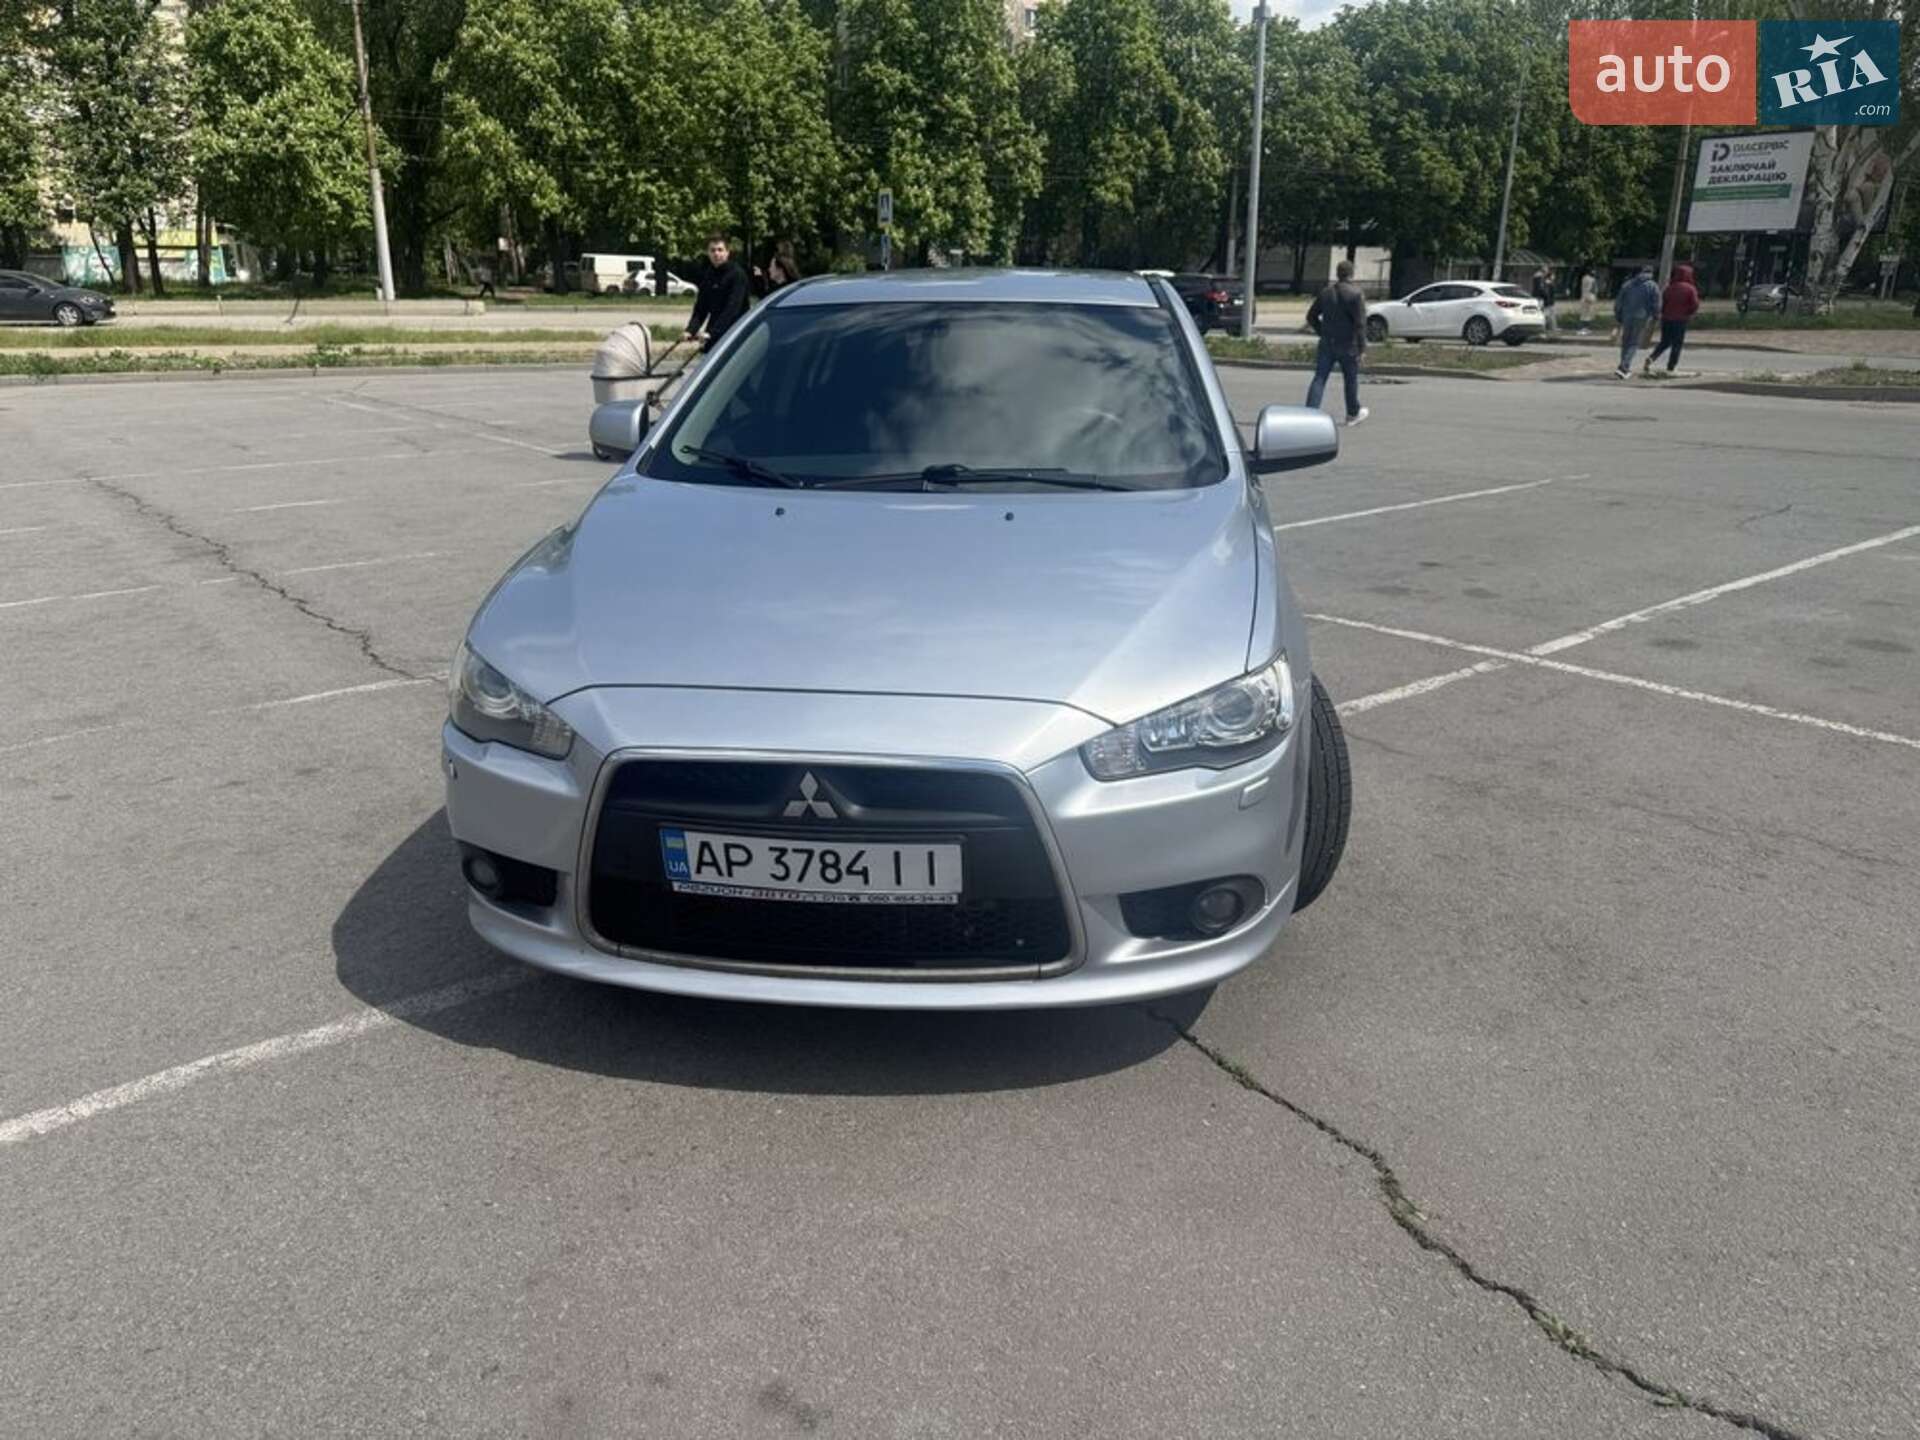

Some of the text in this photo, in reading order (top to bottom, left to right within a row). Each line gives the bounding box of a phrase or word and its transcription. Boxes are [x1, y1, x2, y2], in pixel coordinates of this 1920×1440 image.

[1710, 160, 1777, 173] ЗАКЛЮЧАЙ
[1708, 172, 1788, 185] ДЕКЛАРАЦІЮ
[668, 861, 688, 874] UA
[695, 840, 753, 878] AP
[768, 846, 870, 886] 3784
